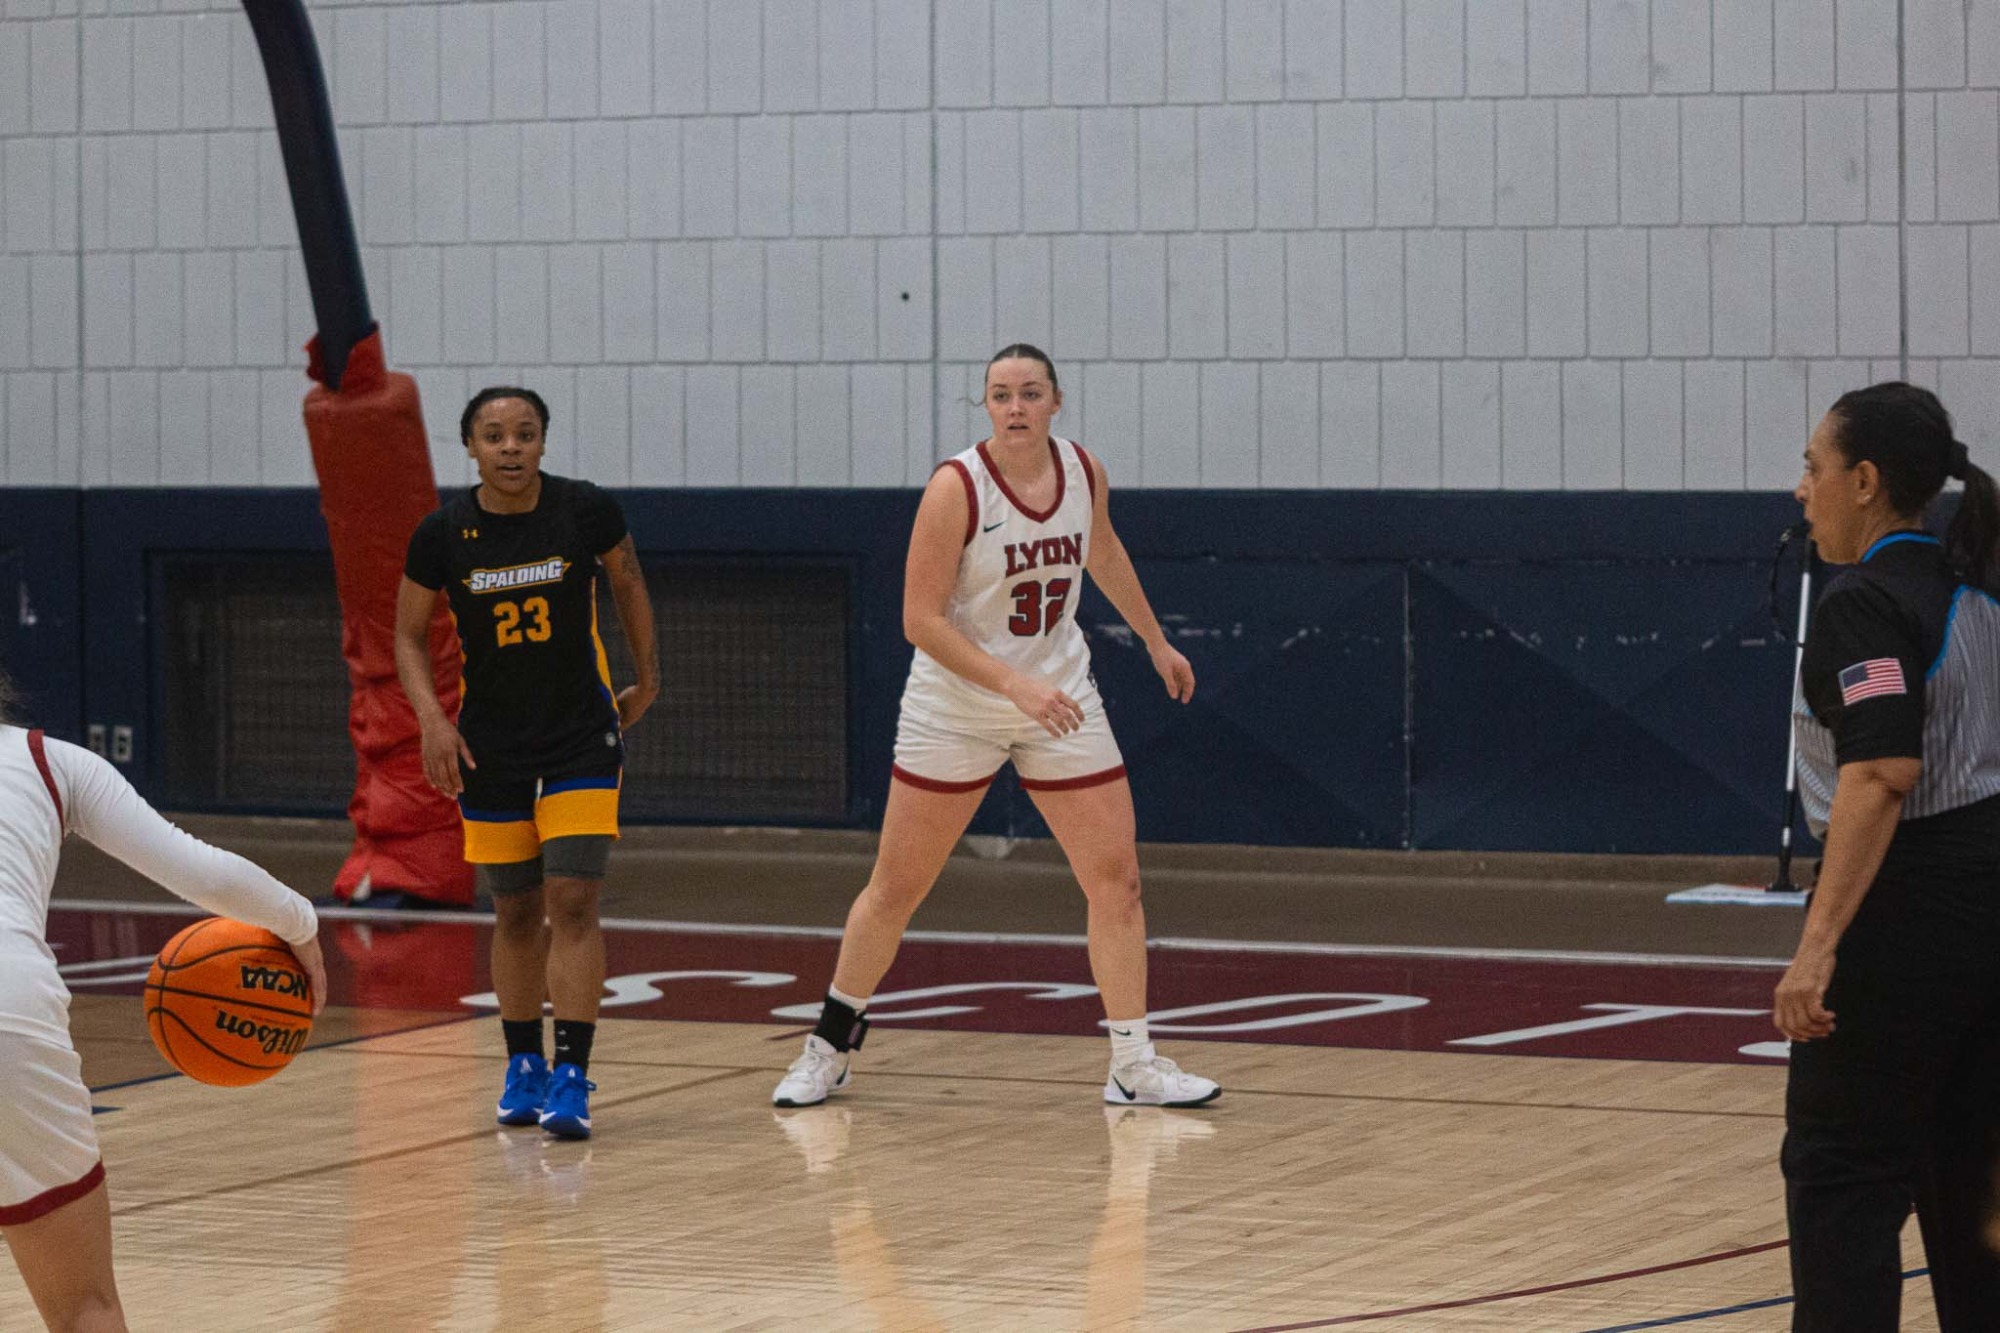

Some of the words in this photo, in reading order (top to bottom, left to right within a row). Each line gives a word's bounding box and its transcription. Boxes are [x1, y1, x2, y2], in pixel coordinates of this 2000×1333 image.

[470, 559, 563, 590] SPALDING
[1004, 533, 1083, 578] LYON
[493, 596, 552, 648] 23
[1008, 578, 1072, 637] 32
[240, 965, 307, 999] NCAA
[215, 1010, 308, 1056] Wilson
[459, 970, 1791, 1058] SCOT
